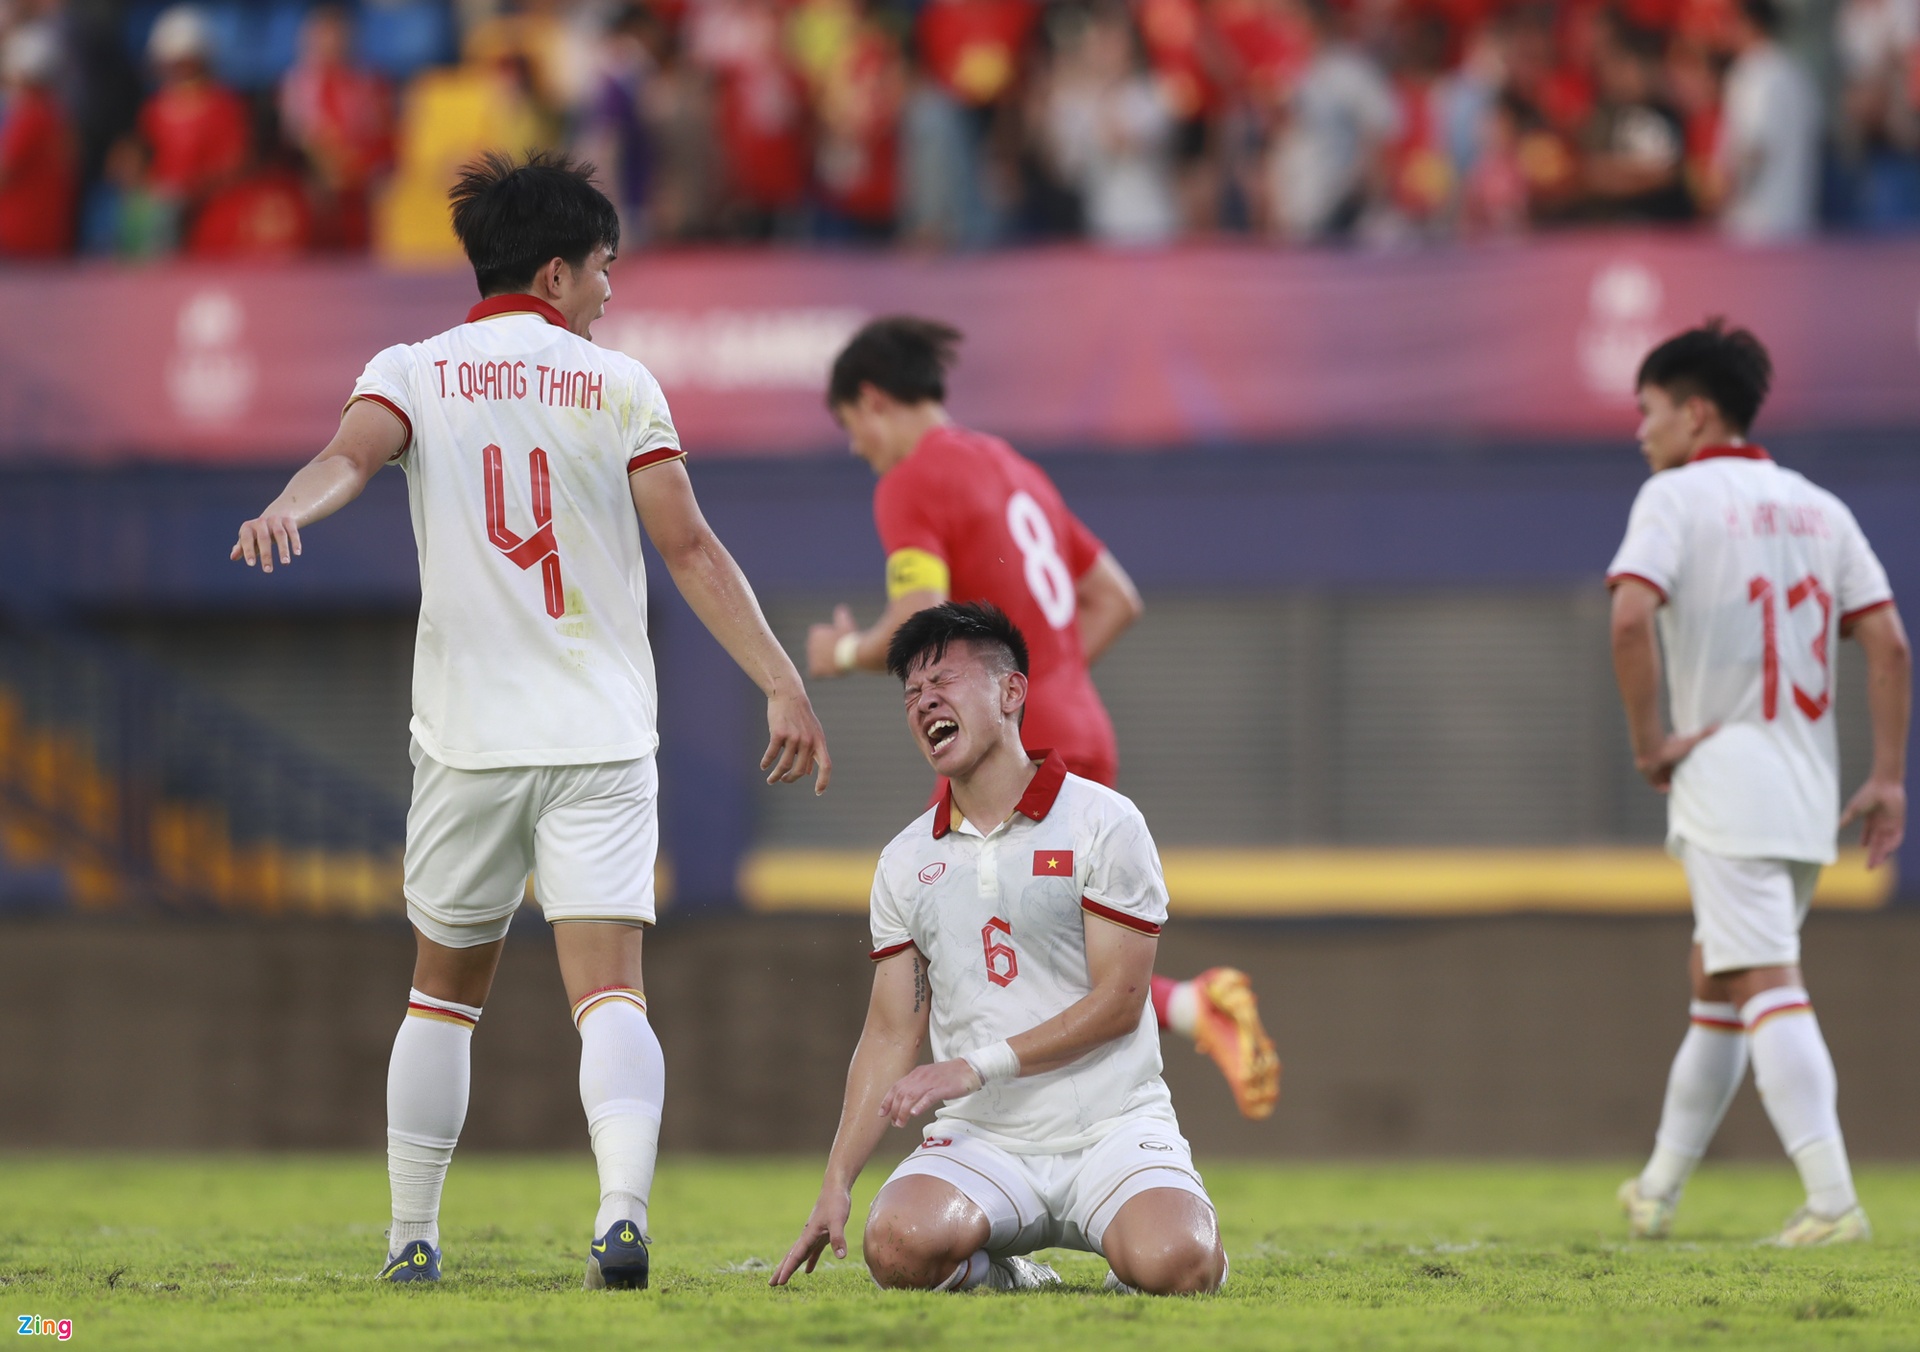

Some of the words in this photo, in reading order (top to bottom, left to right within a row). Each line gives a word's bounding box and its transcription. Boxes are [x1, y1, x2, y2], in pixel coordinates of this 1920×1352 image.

[536, 365, 603, 411] THINH
[482, 443, 565, 620] 4
[1006, 489, 1076, 630] 8
[1748, 573, 1833, 724] 13
[981, 916, 1019, 988] 6
